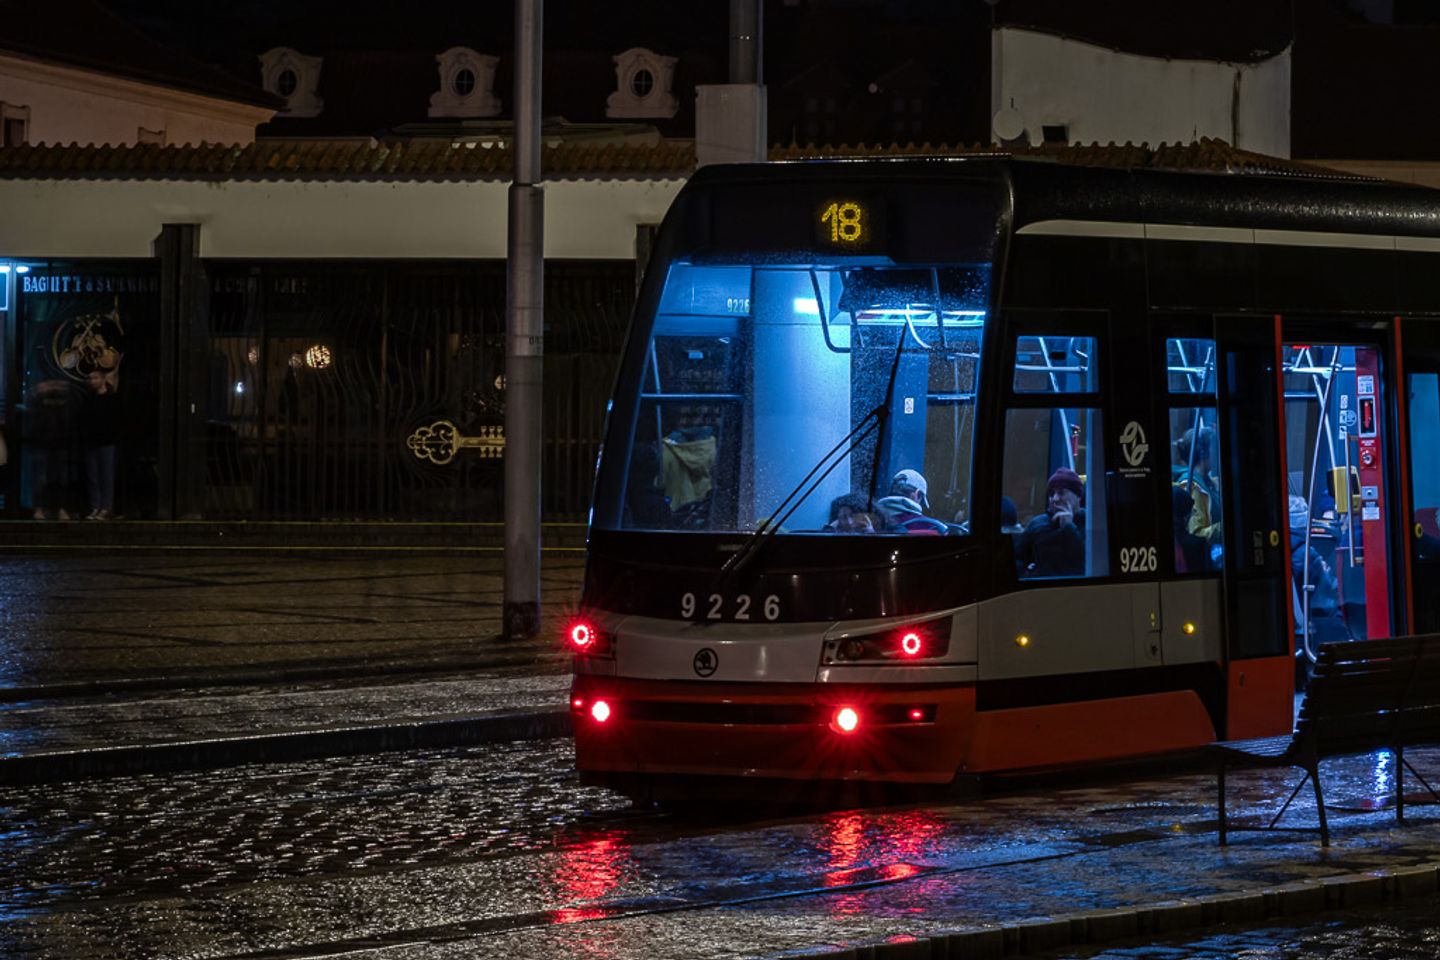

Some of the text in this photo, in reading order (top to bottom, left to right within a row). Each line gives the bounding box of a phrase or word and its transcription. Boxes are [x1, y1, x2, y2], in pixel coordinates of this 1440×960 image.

[822, 203, 861, 242] 18
[727, 298, 751, 313] 9226
[1120, 546, 1157, 573] 9226
[681, 592, 780, 620] 9226
